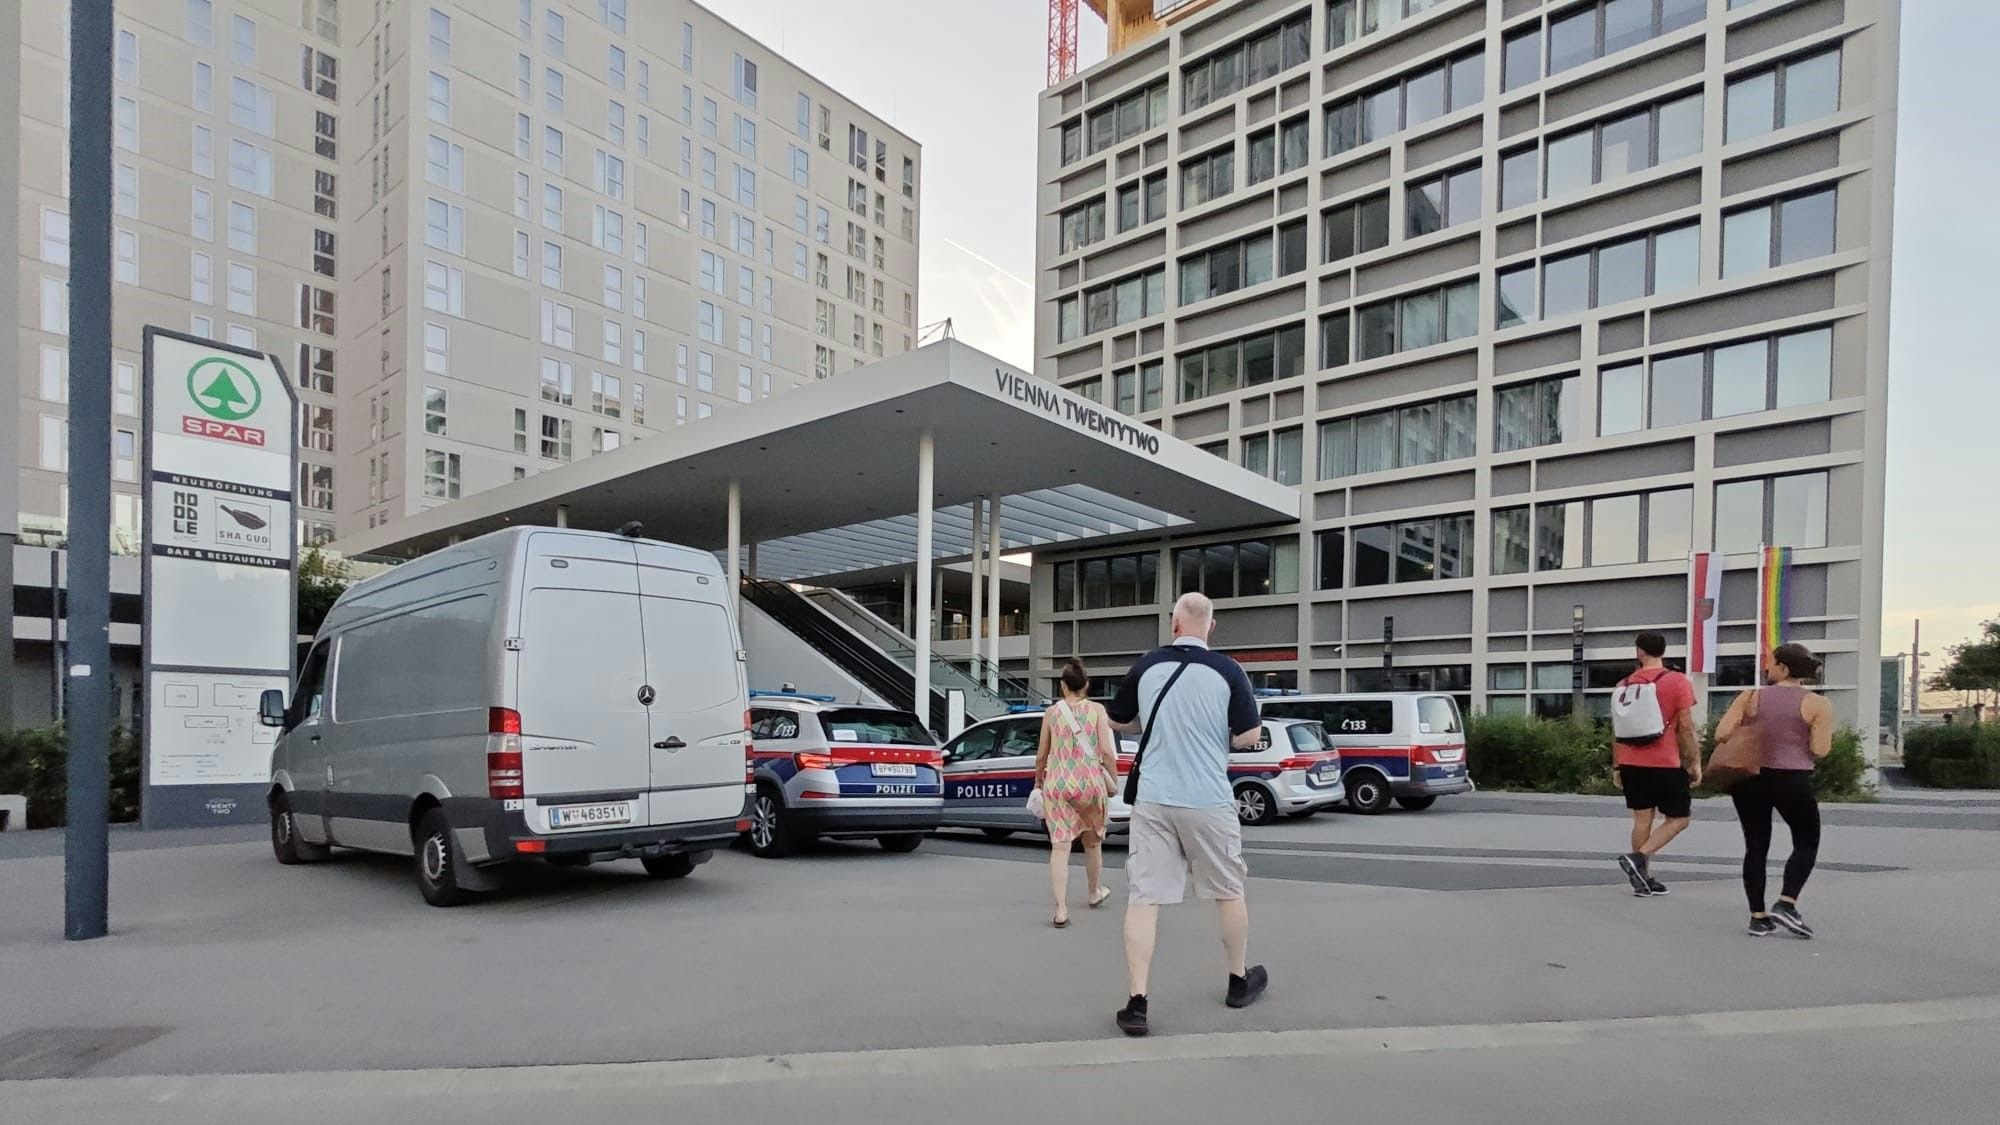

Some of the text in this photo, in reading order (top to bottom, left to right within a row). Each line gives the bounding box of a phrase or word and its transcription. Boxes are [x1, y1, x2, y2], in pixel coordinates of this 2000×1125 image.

[995, 368, 1159, 455] VIENNA TWENTYTWO
[185, 418, 262, 444] SPAR
[172, 475, 273, 498] NEUERÖFFNUNG
[219, 530, 241, 540] SHA
[167, 547, 190, 557] BAR
[208, 552, 277, 566] RESTAURANT
[781, 725, 797, 737] 133
[1350, 720, 1367, 731] 133
[876, 784, 916, 794] POLIZEI
[957, 784, 1009, 798] POLIZEI
